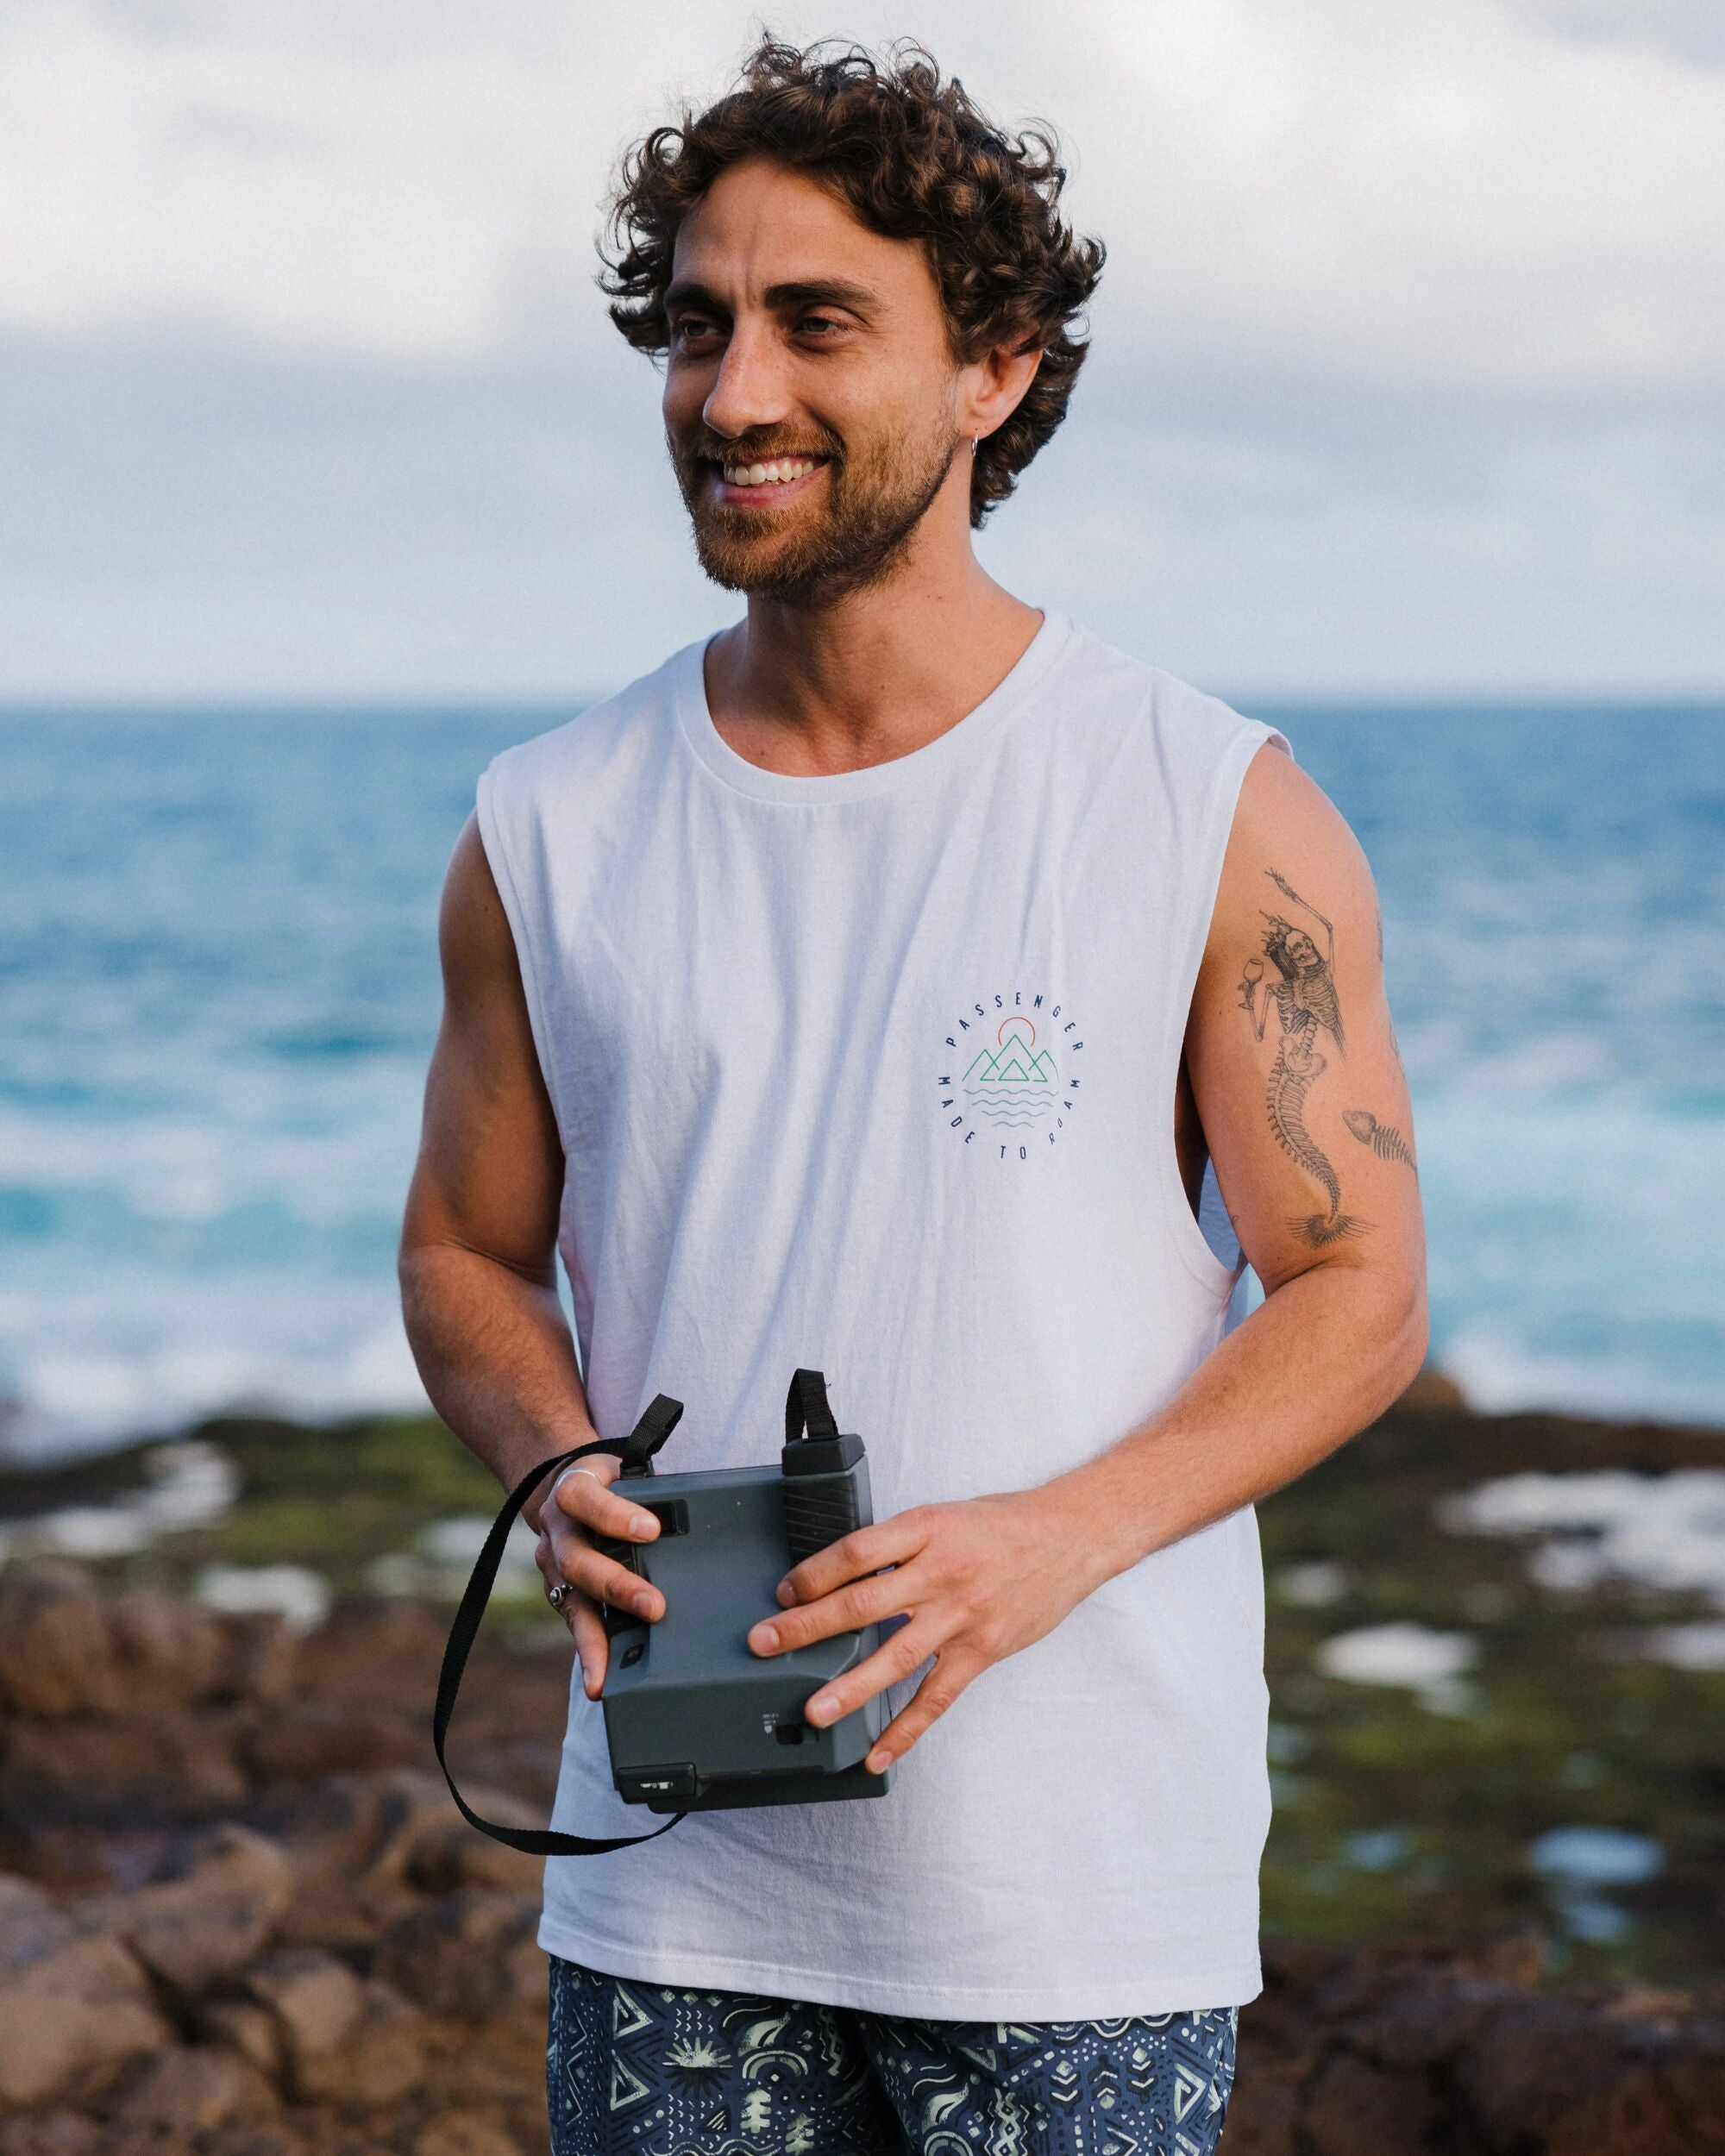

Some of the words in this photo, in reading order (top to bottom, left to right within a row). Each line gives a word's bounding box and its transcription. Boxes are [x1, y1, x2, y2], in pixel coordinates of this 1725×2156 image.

[945, 992, 1083, 1051] PASSENGER
[938, 1076, 975, 1144] MADE
[1000, 1145, 1026, 1159] TO
[1048, 1079, 1080, 1144] ROAM
